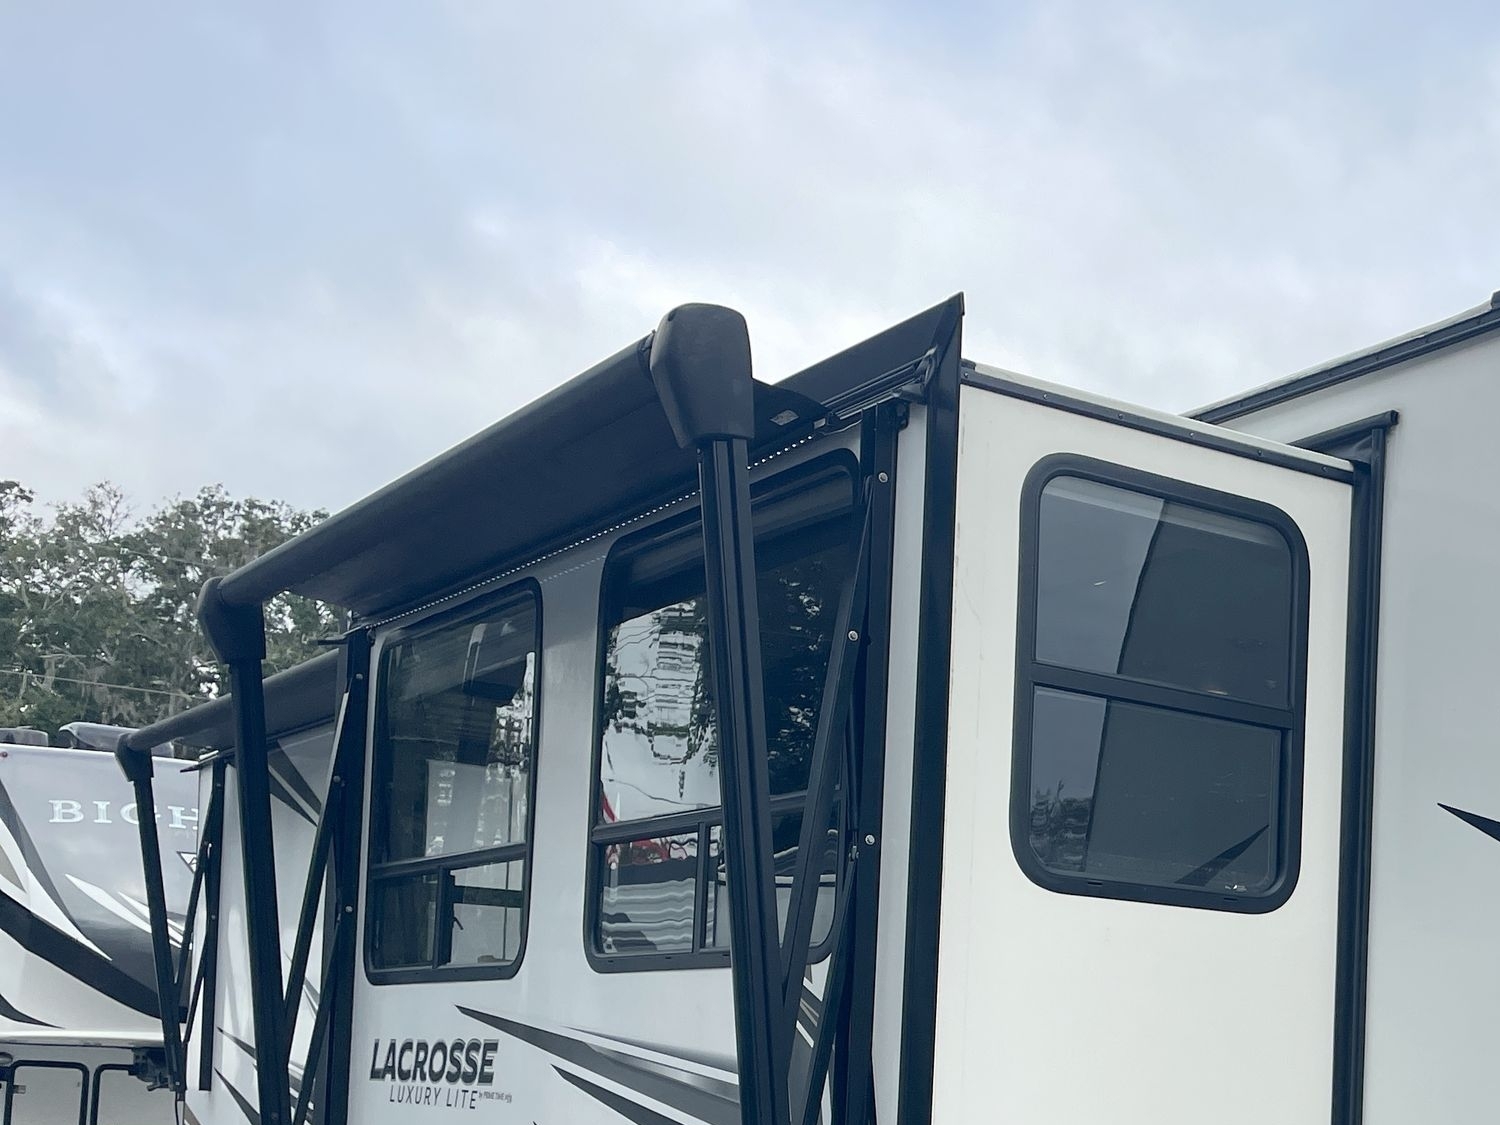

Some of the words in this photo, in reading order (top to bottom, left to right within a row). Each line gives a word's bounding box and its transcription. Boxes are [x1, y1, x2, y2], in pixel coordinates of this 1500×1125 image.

[369, 1038, 499, 1086] LACROSSE
[389, 1084, 442, 1106] LUXURY
[446, 1088, 478, 1110] LITE
